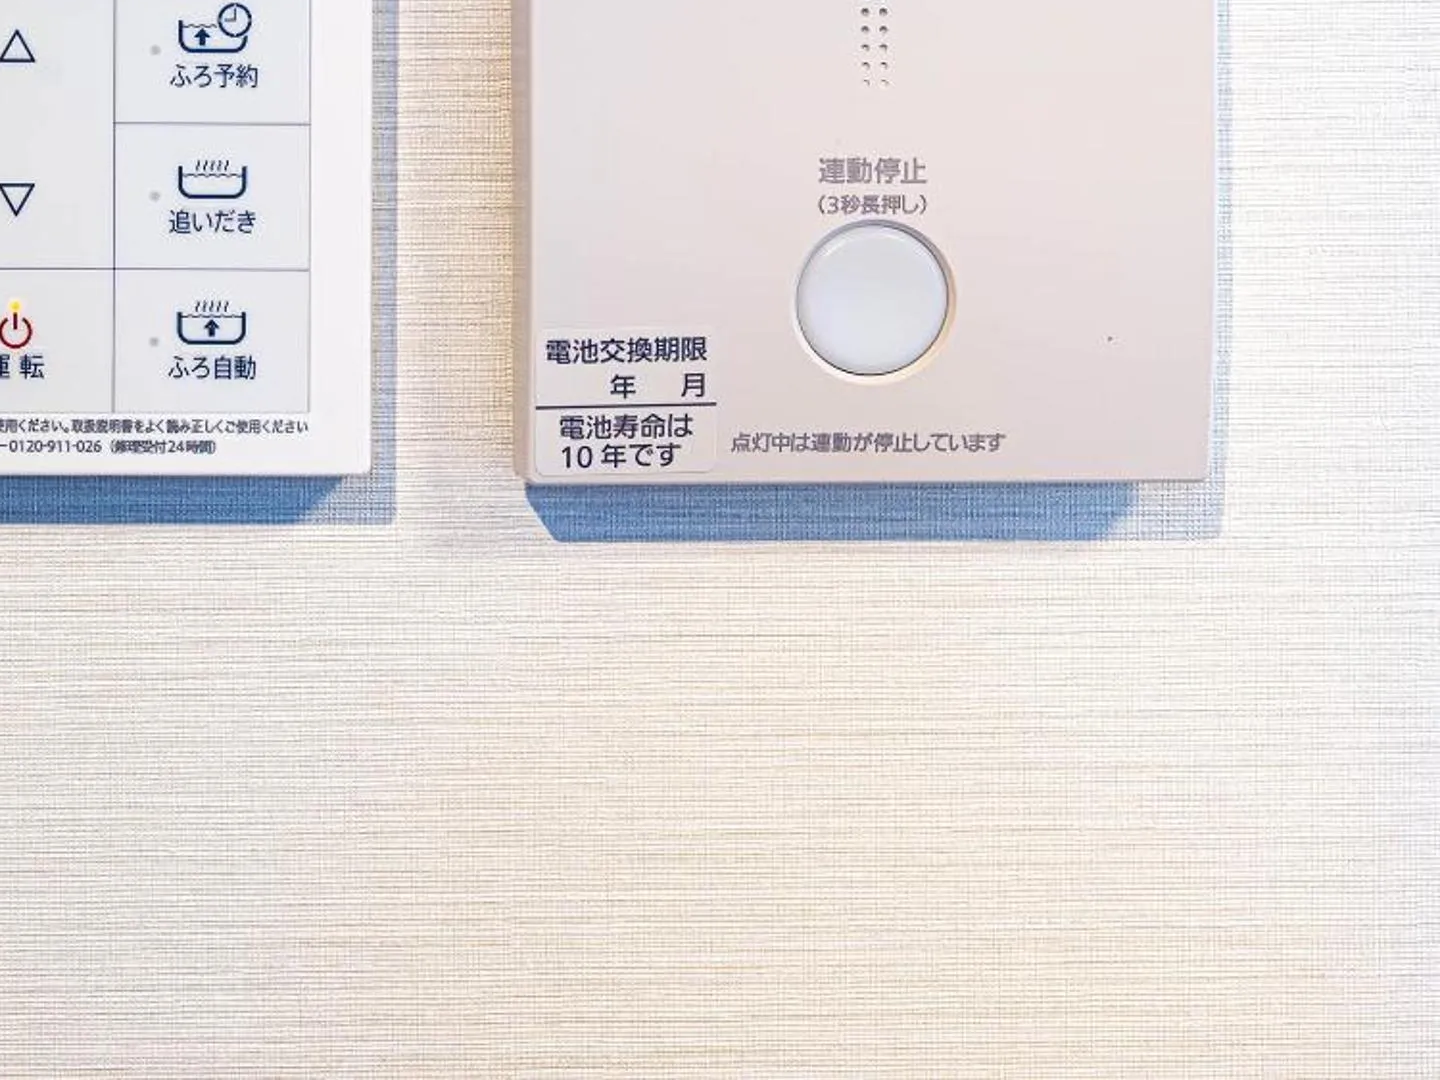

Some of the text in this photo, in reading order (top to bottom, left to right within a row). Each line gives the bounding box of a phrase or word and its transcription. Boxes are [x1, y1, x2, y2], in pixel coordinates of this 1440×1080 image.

[169, 63, 259, 89] ふろ予約
[818, 156, 928, 185] 連動停止
[168, 209, 257, 235] 追いだき
[545, 336, 708, 365] 電池交換期限
[167, 355, 257, 381] ふろ自動
[609, 372, 706, 400] 年 月
[558, 412, 694, 440] 電池寿命は
[561, 442, 682, 469] 10年です
[730, 431, 1006, 454] 点灯中は連動が停止しています
